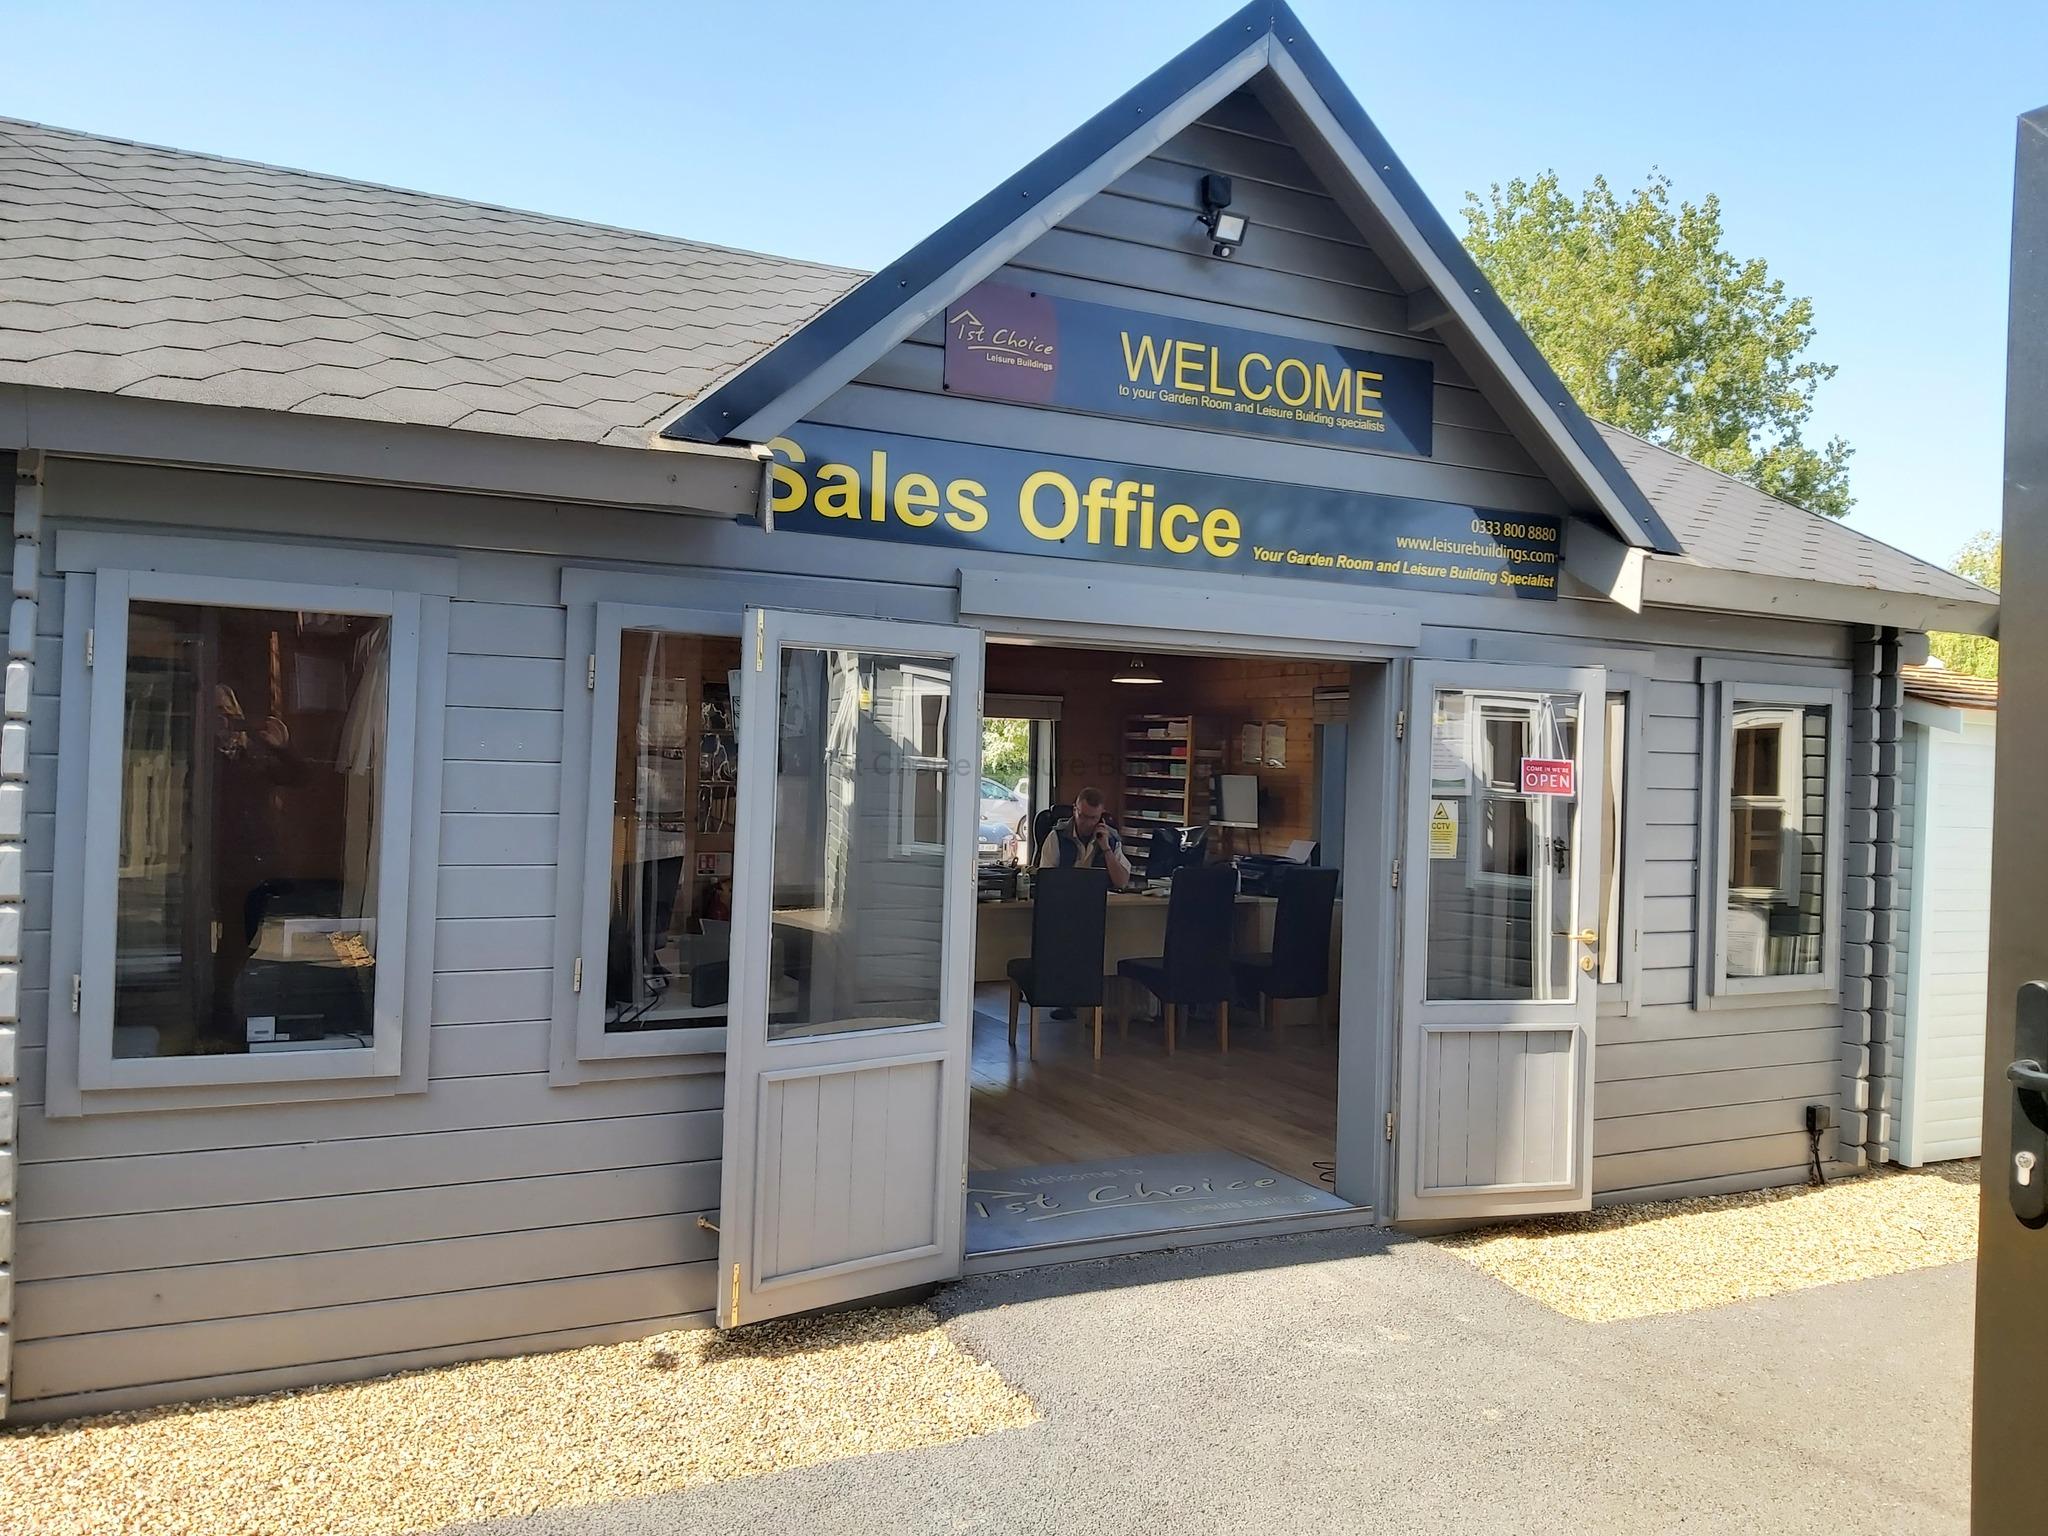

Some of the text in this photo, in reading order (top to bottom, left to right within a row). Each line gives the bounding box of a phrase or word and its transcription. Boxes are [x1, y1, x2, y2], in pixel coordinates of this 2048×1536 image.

[958, 324, 1054, 355] 1st Choice
[986, 352, 1053, 372] Leisure Buildings
[1120, 331, 1384, 419] WELCOME
[1118, 384, 1385, 432] to your Garden Room and Leisure Building specialists
[773, 436, 1241, 558] Sales Office
[1471, 518, 1556, 542] 0333 800 8880
[1396, 535, 1555, 564] www.leisurebuildings.com
[1253, 546, 1555, 588] Your Garden Room and Leisure Building Specialist
[1526, 773, 1570, 788] OPEN
[1431, 822, 1451, 830] CCTV
[975, 1176, 1277, 1219] 1st Choice
